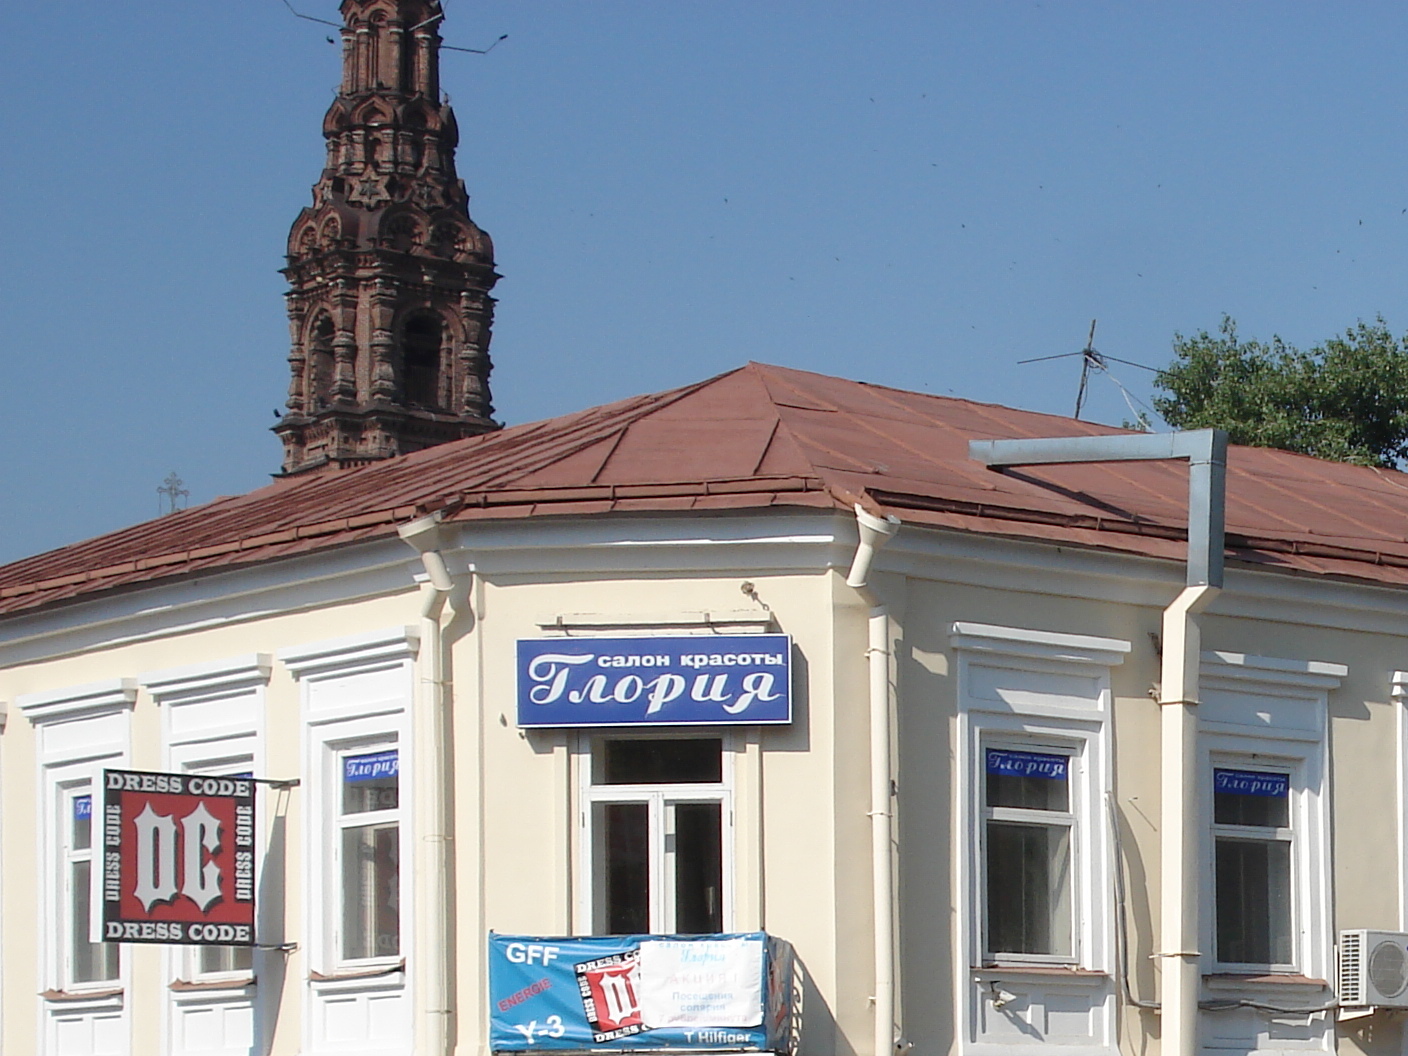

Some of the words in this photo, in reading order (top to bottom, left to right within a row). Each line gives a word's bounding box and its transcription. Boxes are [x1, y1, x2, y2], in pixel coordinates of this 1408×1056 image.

[597, 654, 670, 667] салон
[680, 654, 783, 669] красоты
[528, 653, 785, 716] Глория
[988, 752, 1064, 777] Глория
[106, 773, 183, 793] DRESS
[188, 779, 250, 797] CODE
[1216, 772, 1285, 795] Глория
[105, 804, 121, 847] CODE
[235, 805, 253, 847] CODE
[105, 851, 121, 901] DRESS
[235, 851, 253, 900] DRESS
[106, 921, 183, 940] DRESS
[188, 924, 250, 941] CODE
[506, 943, 559, 966] GFF
[577, 954, 622, 973] DRESS
[624, 950, 640, 960] CO
[498, 977, 552, 1012] ENERGIE
[672, 991, 734, 1002] Посещения
[514, 1015, 565, 1044] Y-3
[594, 1024, 639, 1042] DRESS
[684, 1031, 694, 1043] T
[697, 1030, 751, 1044] Hilfiger
